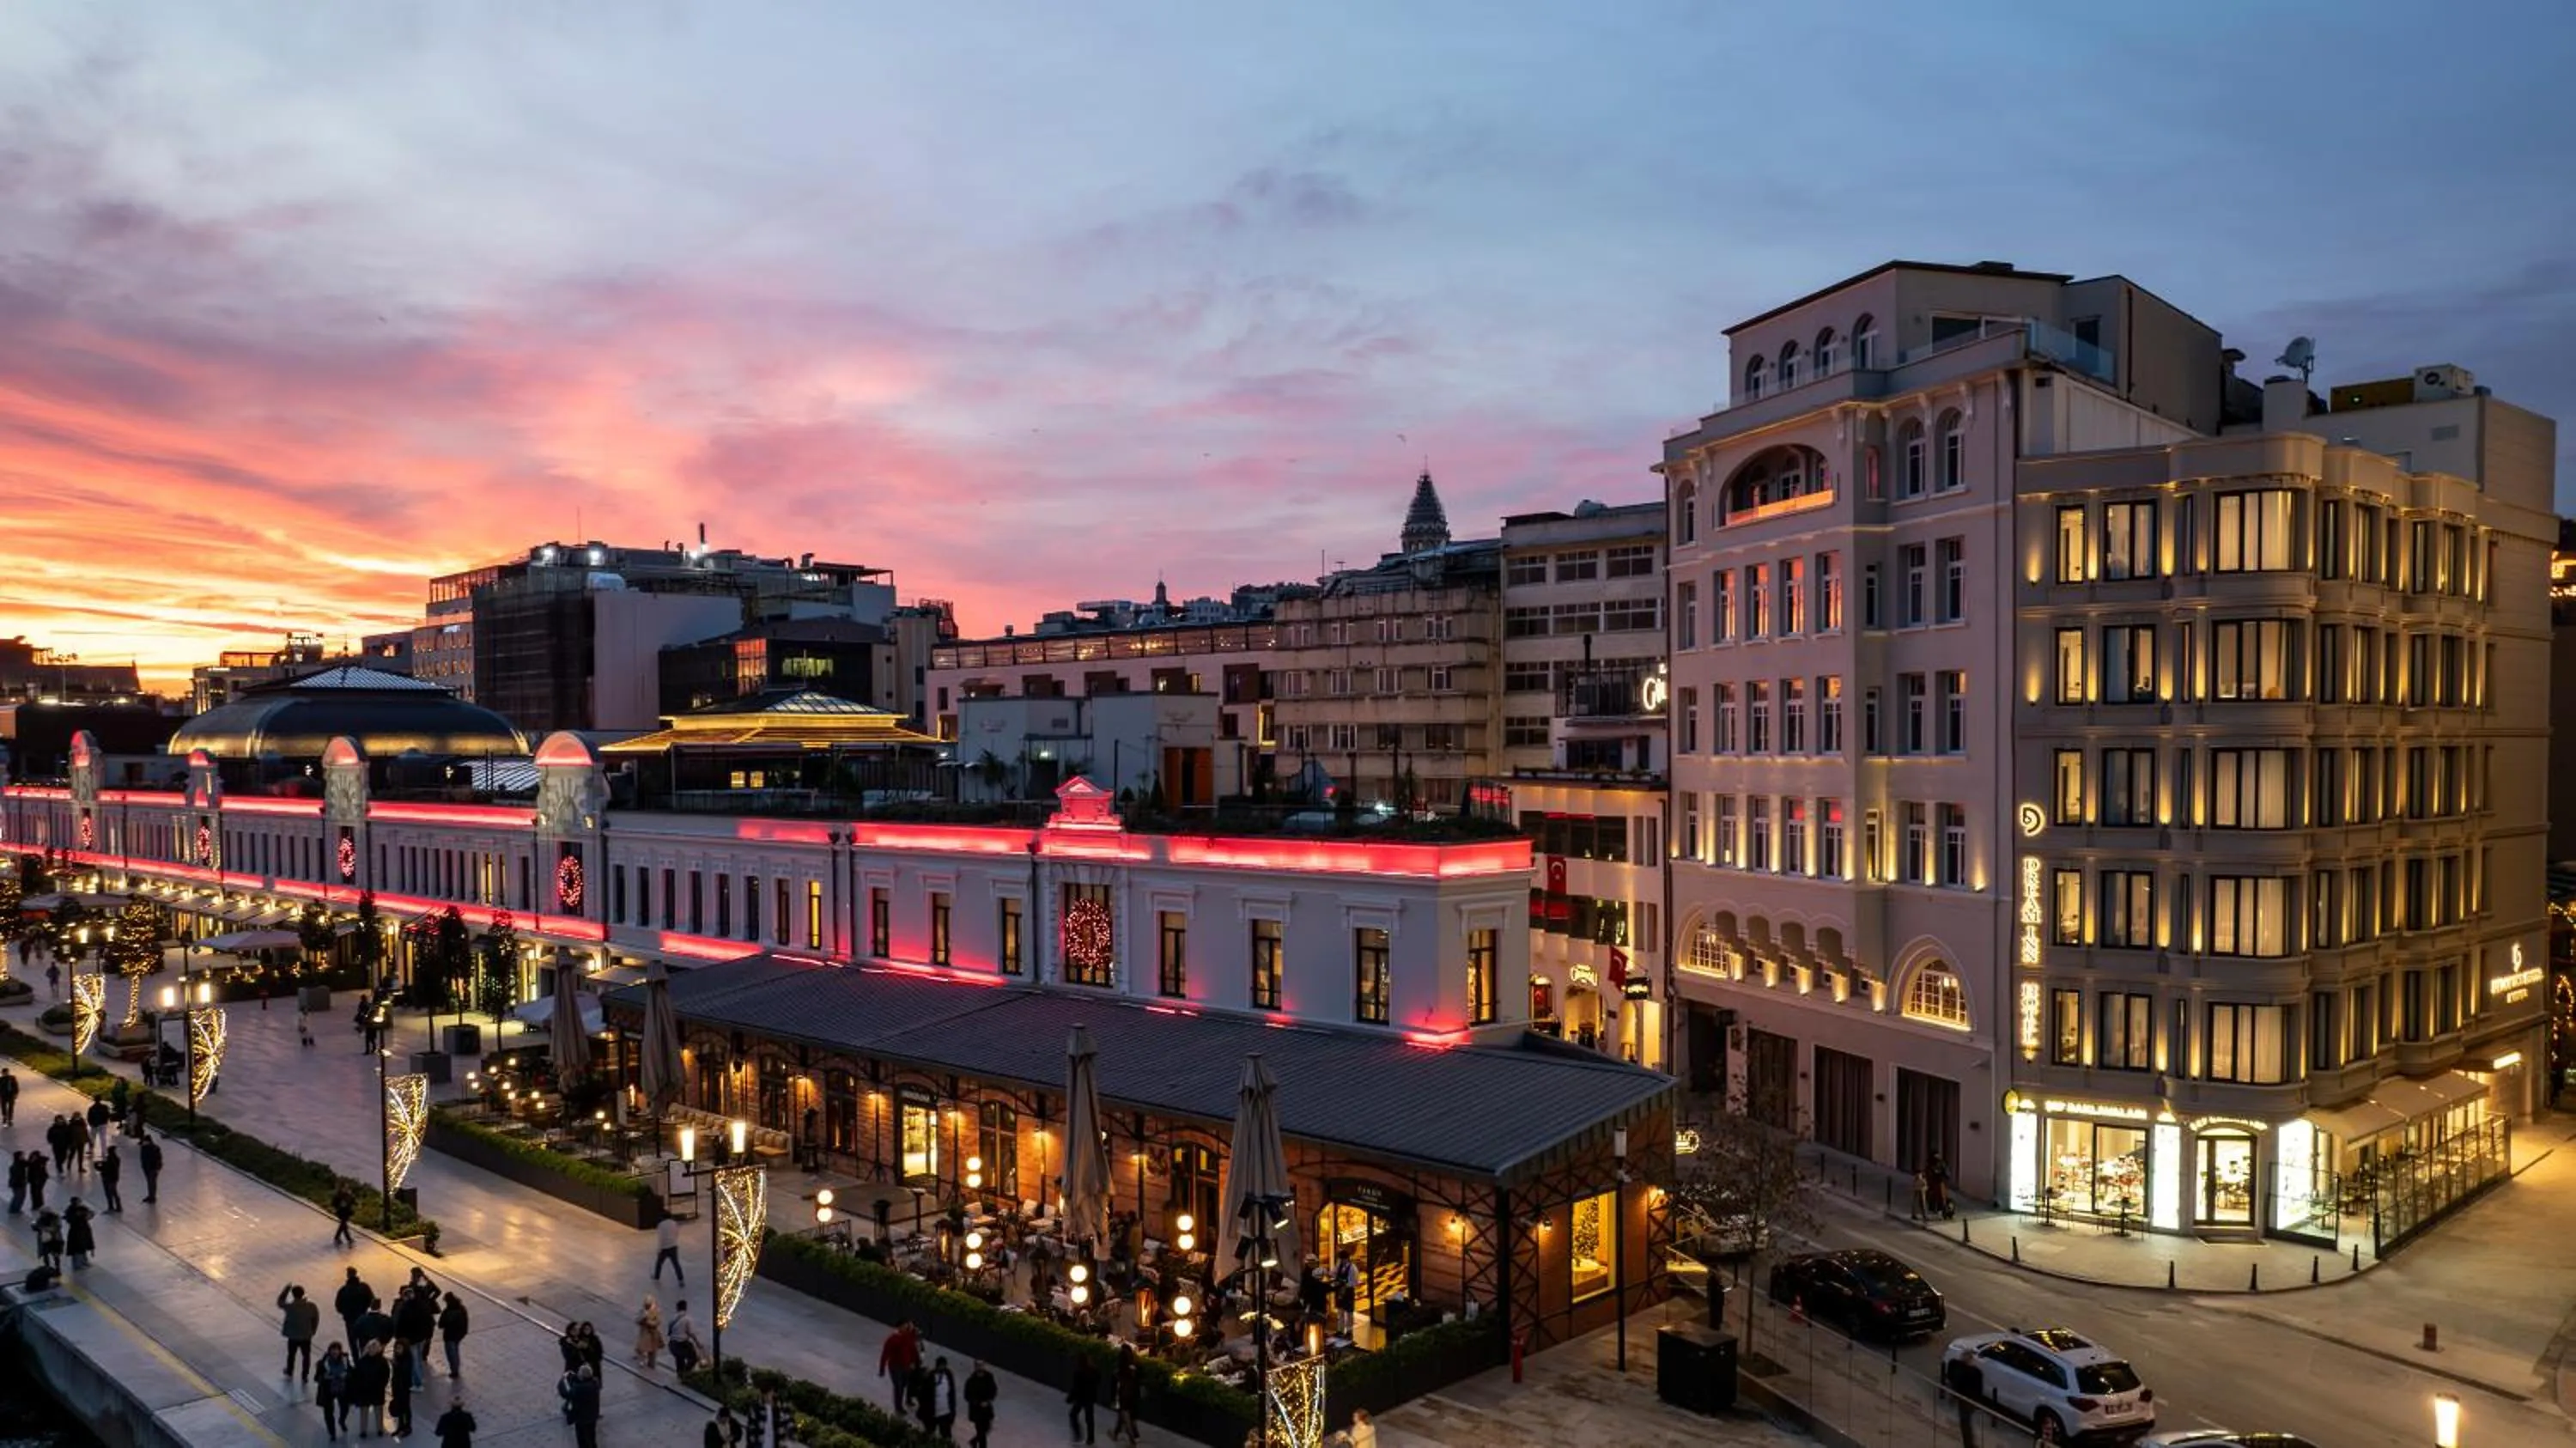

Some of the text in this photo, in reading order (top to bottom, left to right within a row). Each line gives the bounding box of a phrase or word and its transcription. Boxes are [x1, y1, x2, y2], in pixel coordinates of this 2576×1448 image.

[2020, 857, 2041, 1045] DREAM INN HOTEL
